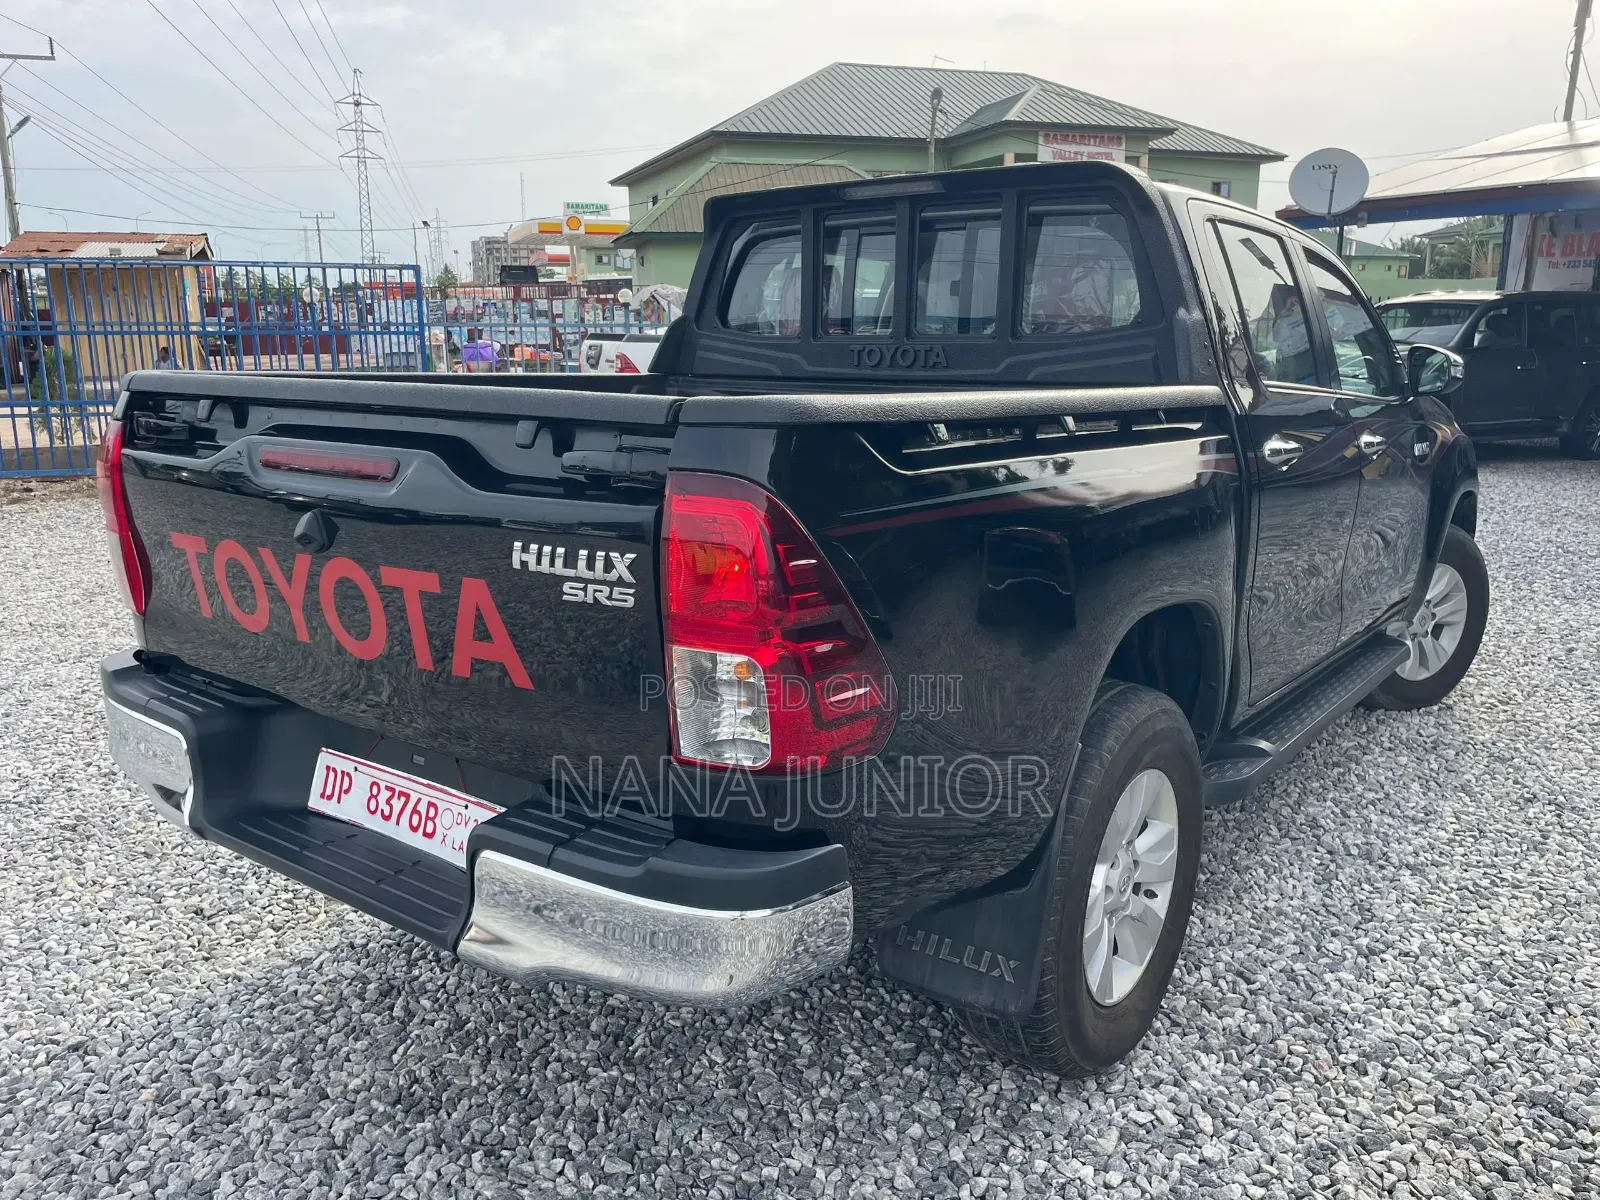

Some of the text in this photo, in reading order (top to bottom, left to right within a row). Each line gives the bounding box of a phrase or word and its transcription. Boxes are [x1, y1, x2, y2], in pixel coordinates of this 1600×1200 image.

[1043, 133, 1123, 148] SAMARITANS
[1052, 150, 1085, 160] VALLEY
[566, 202, 608, 211] SAMARITANS
[849, 344, 948, 368] TOYOTA
[511, 541, 638, 583] HILUX
[562, 581, 636, 608] SR5
[170, 531, 535, 690] TOYOTA
[319, 764, 439, 840] DP 8376B
[455, 811, 471, 829] DV
[896, 925, 1020, 983] HILUX
